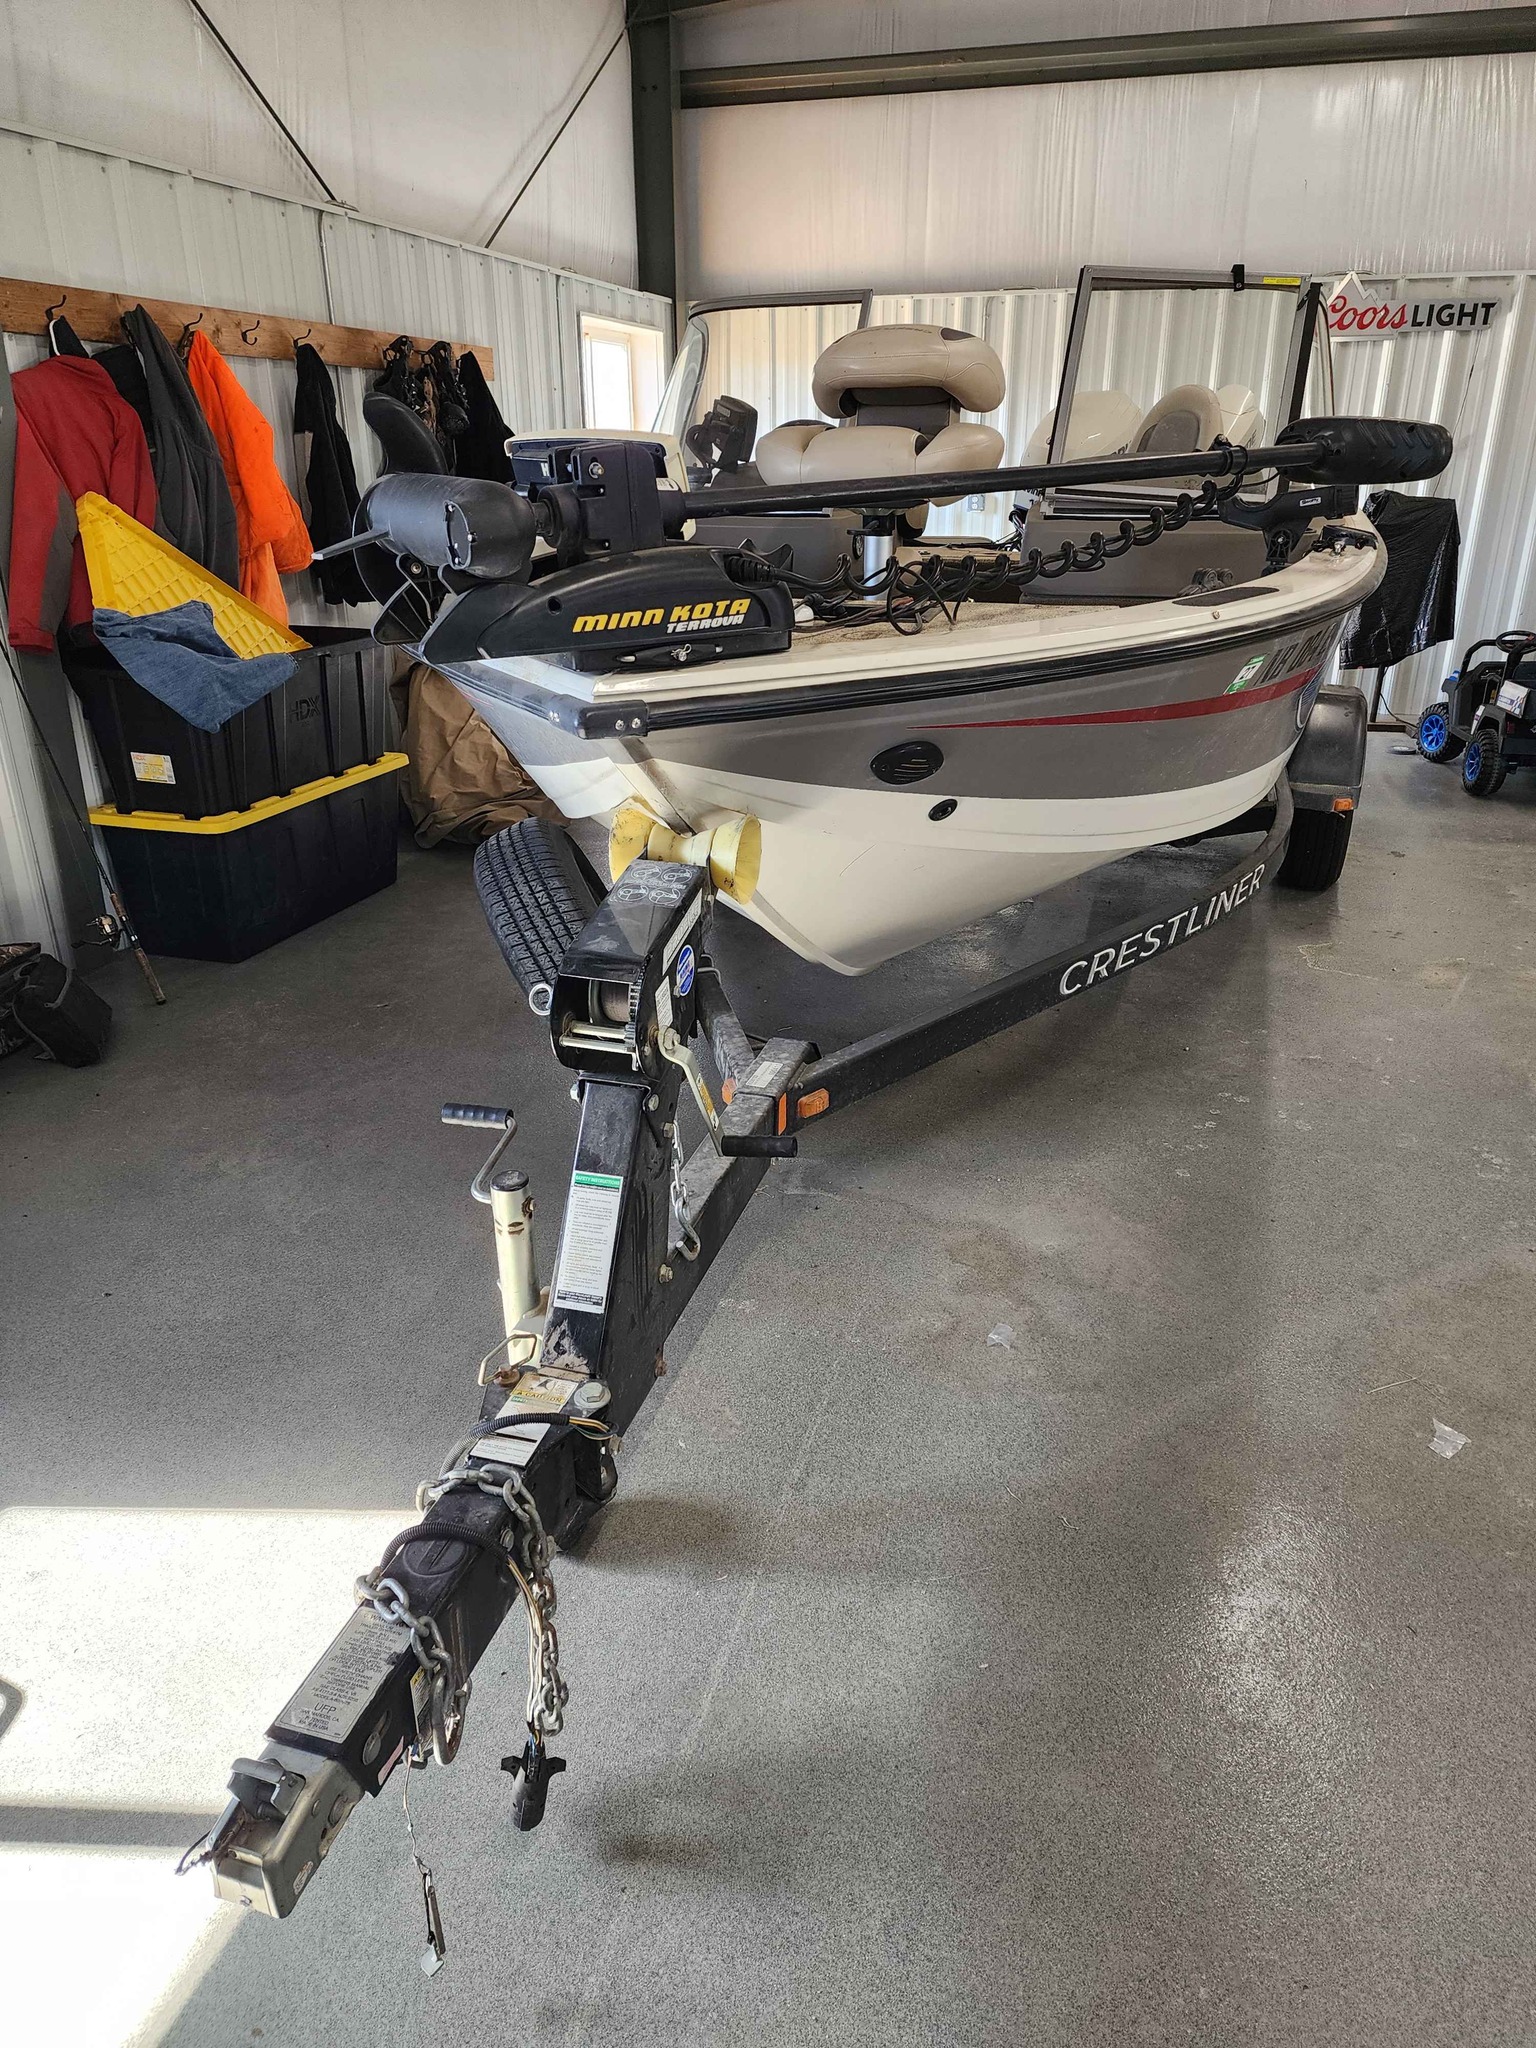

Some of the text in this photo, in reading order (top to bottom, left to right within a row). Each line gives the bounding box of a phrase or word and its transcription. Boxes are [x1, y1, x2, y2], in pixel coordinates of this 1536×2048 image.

[1328, 295, 1498, 331] Coors LIGHT
[572, 598, 752, 633] MINN KOTA
[666, 614, 746, 634] TERROVA
[290, 695, 321, 723] HDX
[1059, 863, 1266, 996] CRESTLINER
[314, 1702, 337, 1714] UFP
